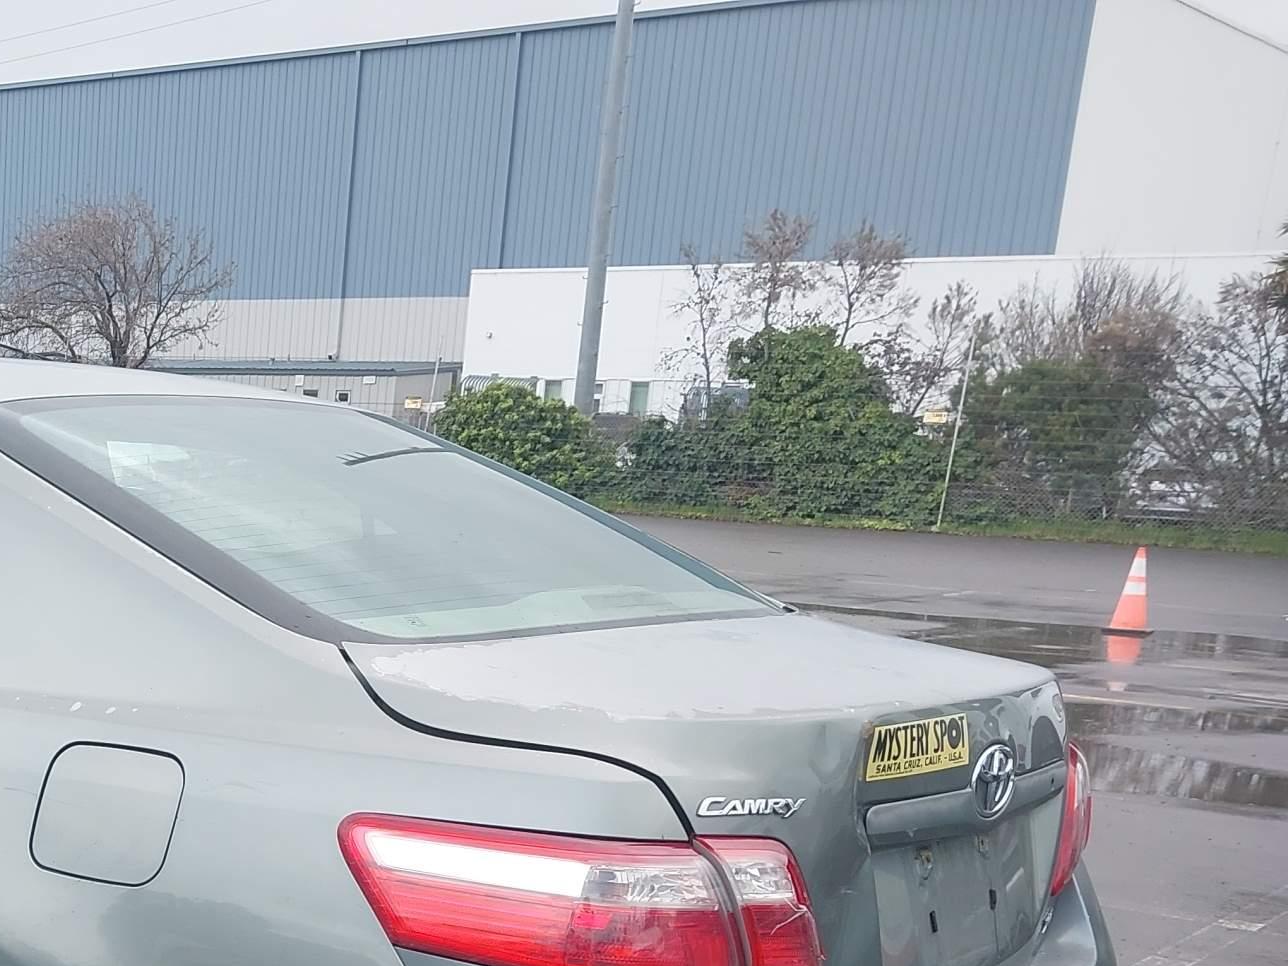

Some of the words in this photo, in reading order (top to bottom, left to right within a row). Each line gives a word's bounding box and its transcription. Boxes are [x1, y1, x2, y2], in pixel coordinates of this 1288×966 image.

[872, 721, 930, 763] MYSTERY
[933, 716, 965, 753] SPOT
[875, 762, 901, 774] SANTA
[903, 759, 923, 770] CRUZ,
[697, 796, 807, 819] CAMRY
